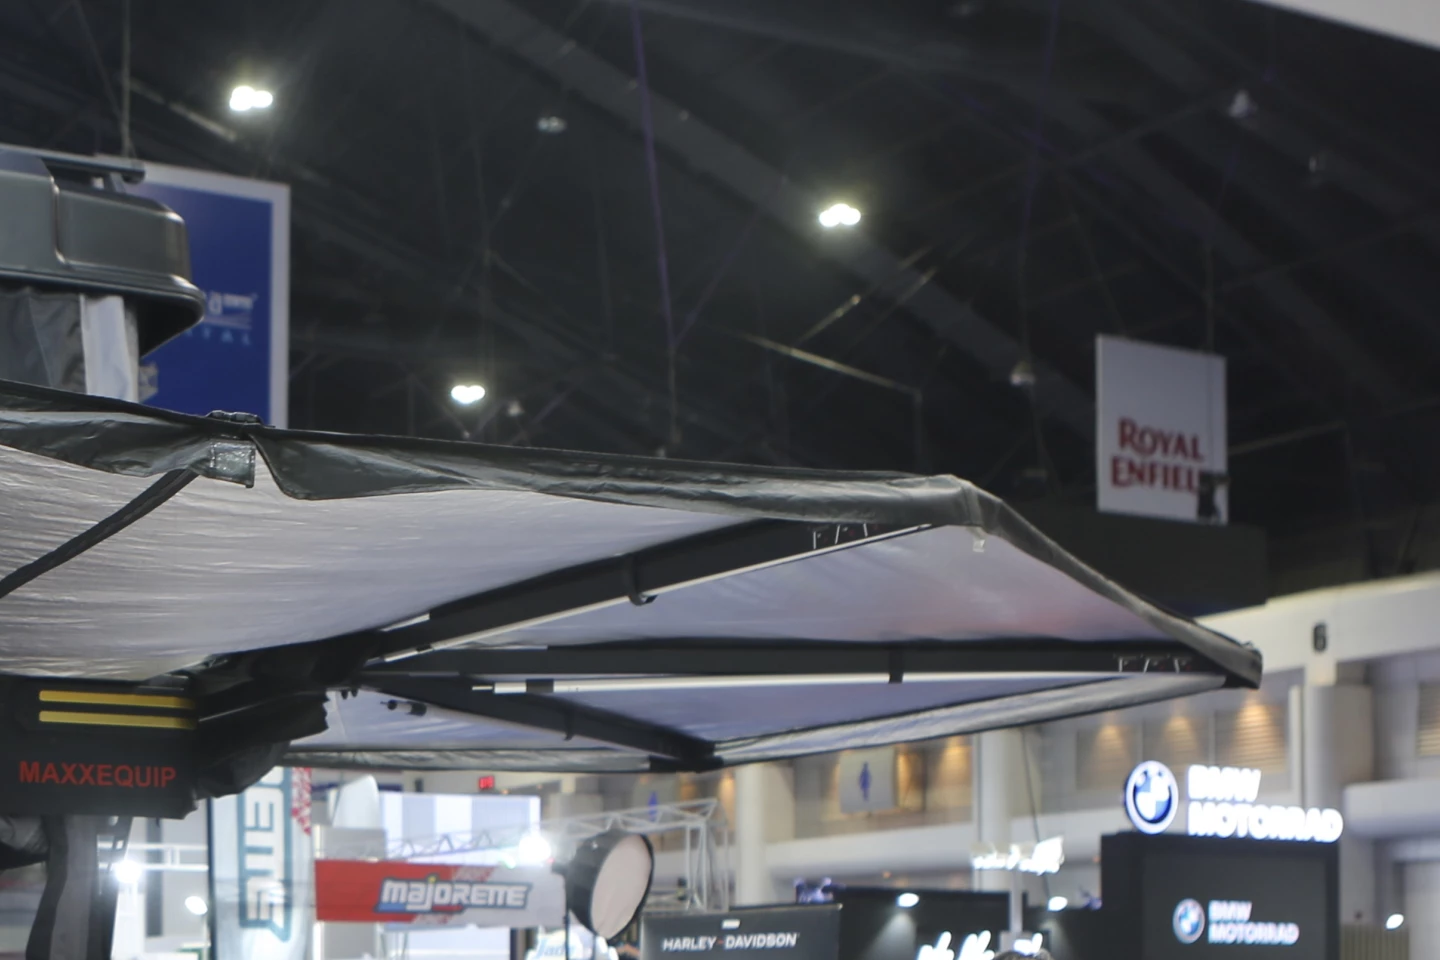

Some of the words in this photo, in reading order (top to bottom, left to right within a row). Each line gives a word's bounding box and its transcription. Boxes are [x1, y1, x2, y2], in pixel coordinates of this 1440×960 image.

[1110, 455, 1202, 497] ENFIEL
[18, 760, 177, 788] MAXXEQUIP
[1209, 900, 1253, 922] BMW
[1209, 921, 1300, 945] MOTORRAD
